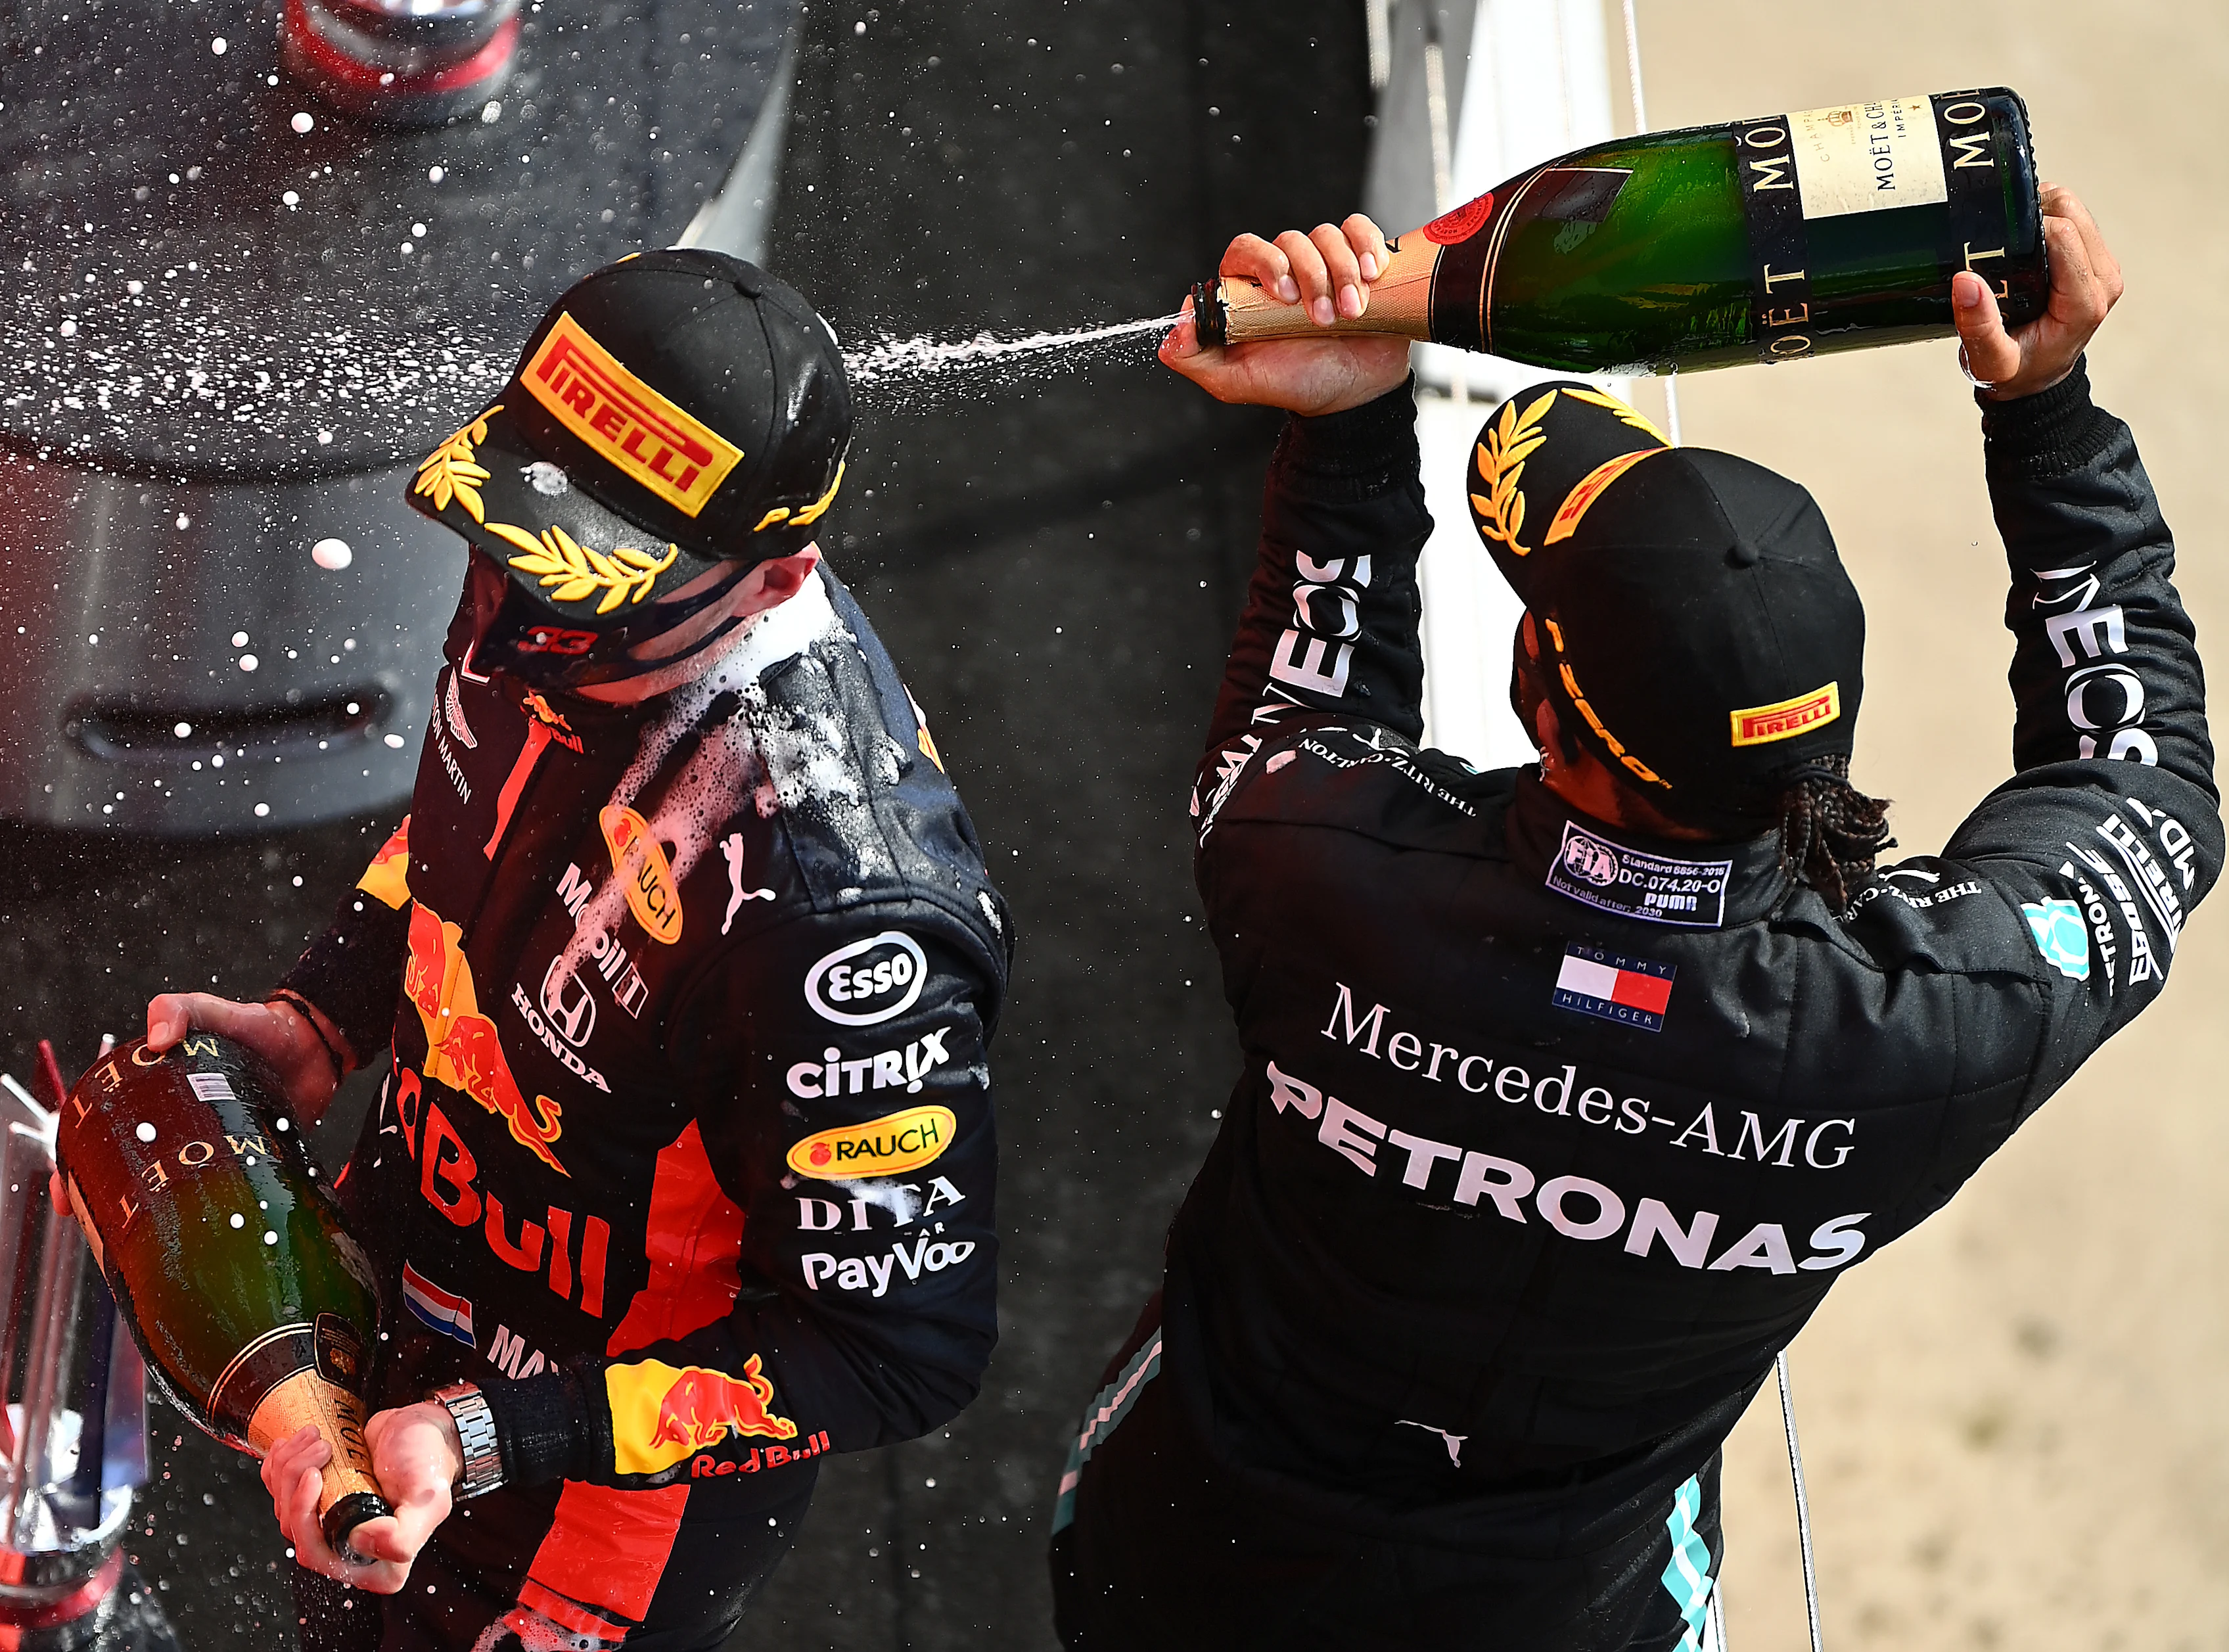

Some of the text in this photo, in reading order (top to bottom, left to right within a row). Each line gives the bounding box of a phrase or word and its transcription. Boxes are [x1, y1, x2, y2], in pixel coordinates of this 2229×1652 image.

[1870, 134, 1896, 191] MOËT
[1762, 264, 1811, 356] OËT
[536, 334, 713, 493] PIRELLI
[518, 626, 597, 654] 33
[1743, 695, 1831, 738] PIRELLI
[432, 693, 472, 805] TON MARTIN
[1298, 738, 1477, 817] THE RITZ-CLTON
[1621, 854, 1672, 873] Standard
[2159, 818, 2195, 891] MD
[1634, 906, 1663, 917] 2030
[1935, 881, 1982, 904] THE
[1577, 946, 1667, 975] TOMMY
[1562, 993, 1652, 1025] HILFIGER
[511, 982, 612, 1093] HONDA
[1321, 981, 1856, 1170] Mercedes-AMG
[837, 1118, 939, 1161] RAUCH
[1267, 1060, 1872, 1275] PETRONAS
[794, 1176, 966, 1228] DITA
[487, 1323, 559, 1381] MA
[691, 1447, 762, 1479] Red
